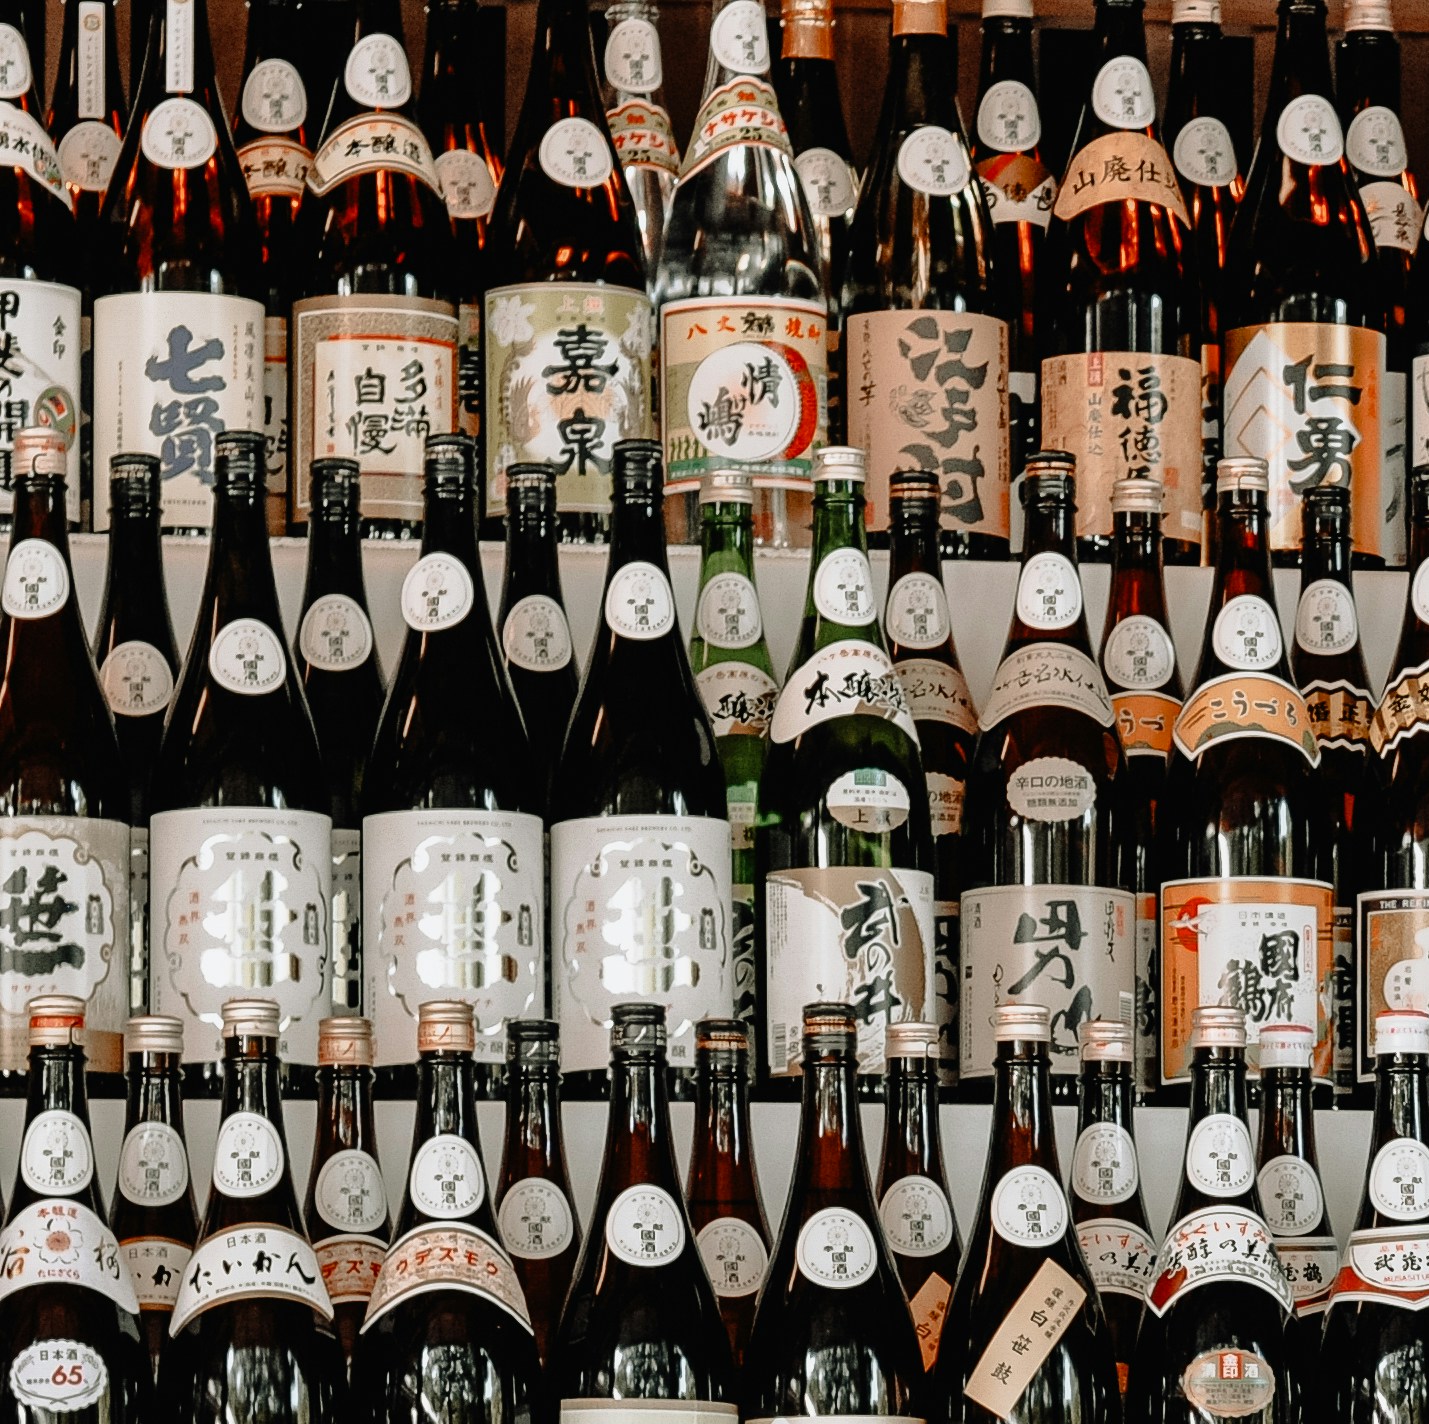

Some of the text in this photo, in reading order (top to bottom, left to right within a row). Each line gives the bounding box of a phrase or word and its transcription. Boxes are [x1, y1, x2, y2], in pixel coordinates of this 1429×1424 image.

[146, 325, 227, 486] 七賢
[346, 367, 392, 455] 自慢
[543, 325, 618, 475] 嘉泉
[1283, 354, 1362, 497] 仁勇
[1212, 689, 1298, 726] こうづる
[1016, 775, 1088, 790] 辛口の地酒
[1380, 898, 1399, 909] THE
[840, 881, 916, 1027] 武の井
[128, 1246, 169, 1260] 日本酒
[226, 1231, 268, 1249] 日本酒
[188, 1249, 316, 1290] たいかん
[39, 1348, 79, 1362] 日本酒
[988, 1304, 1052, 1387] 白笹鼓
[51, 1364, 84, 1386] 65
[1221, 1353, 1240, 1378] 金印
